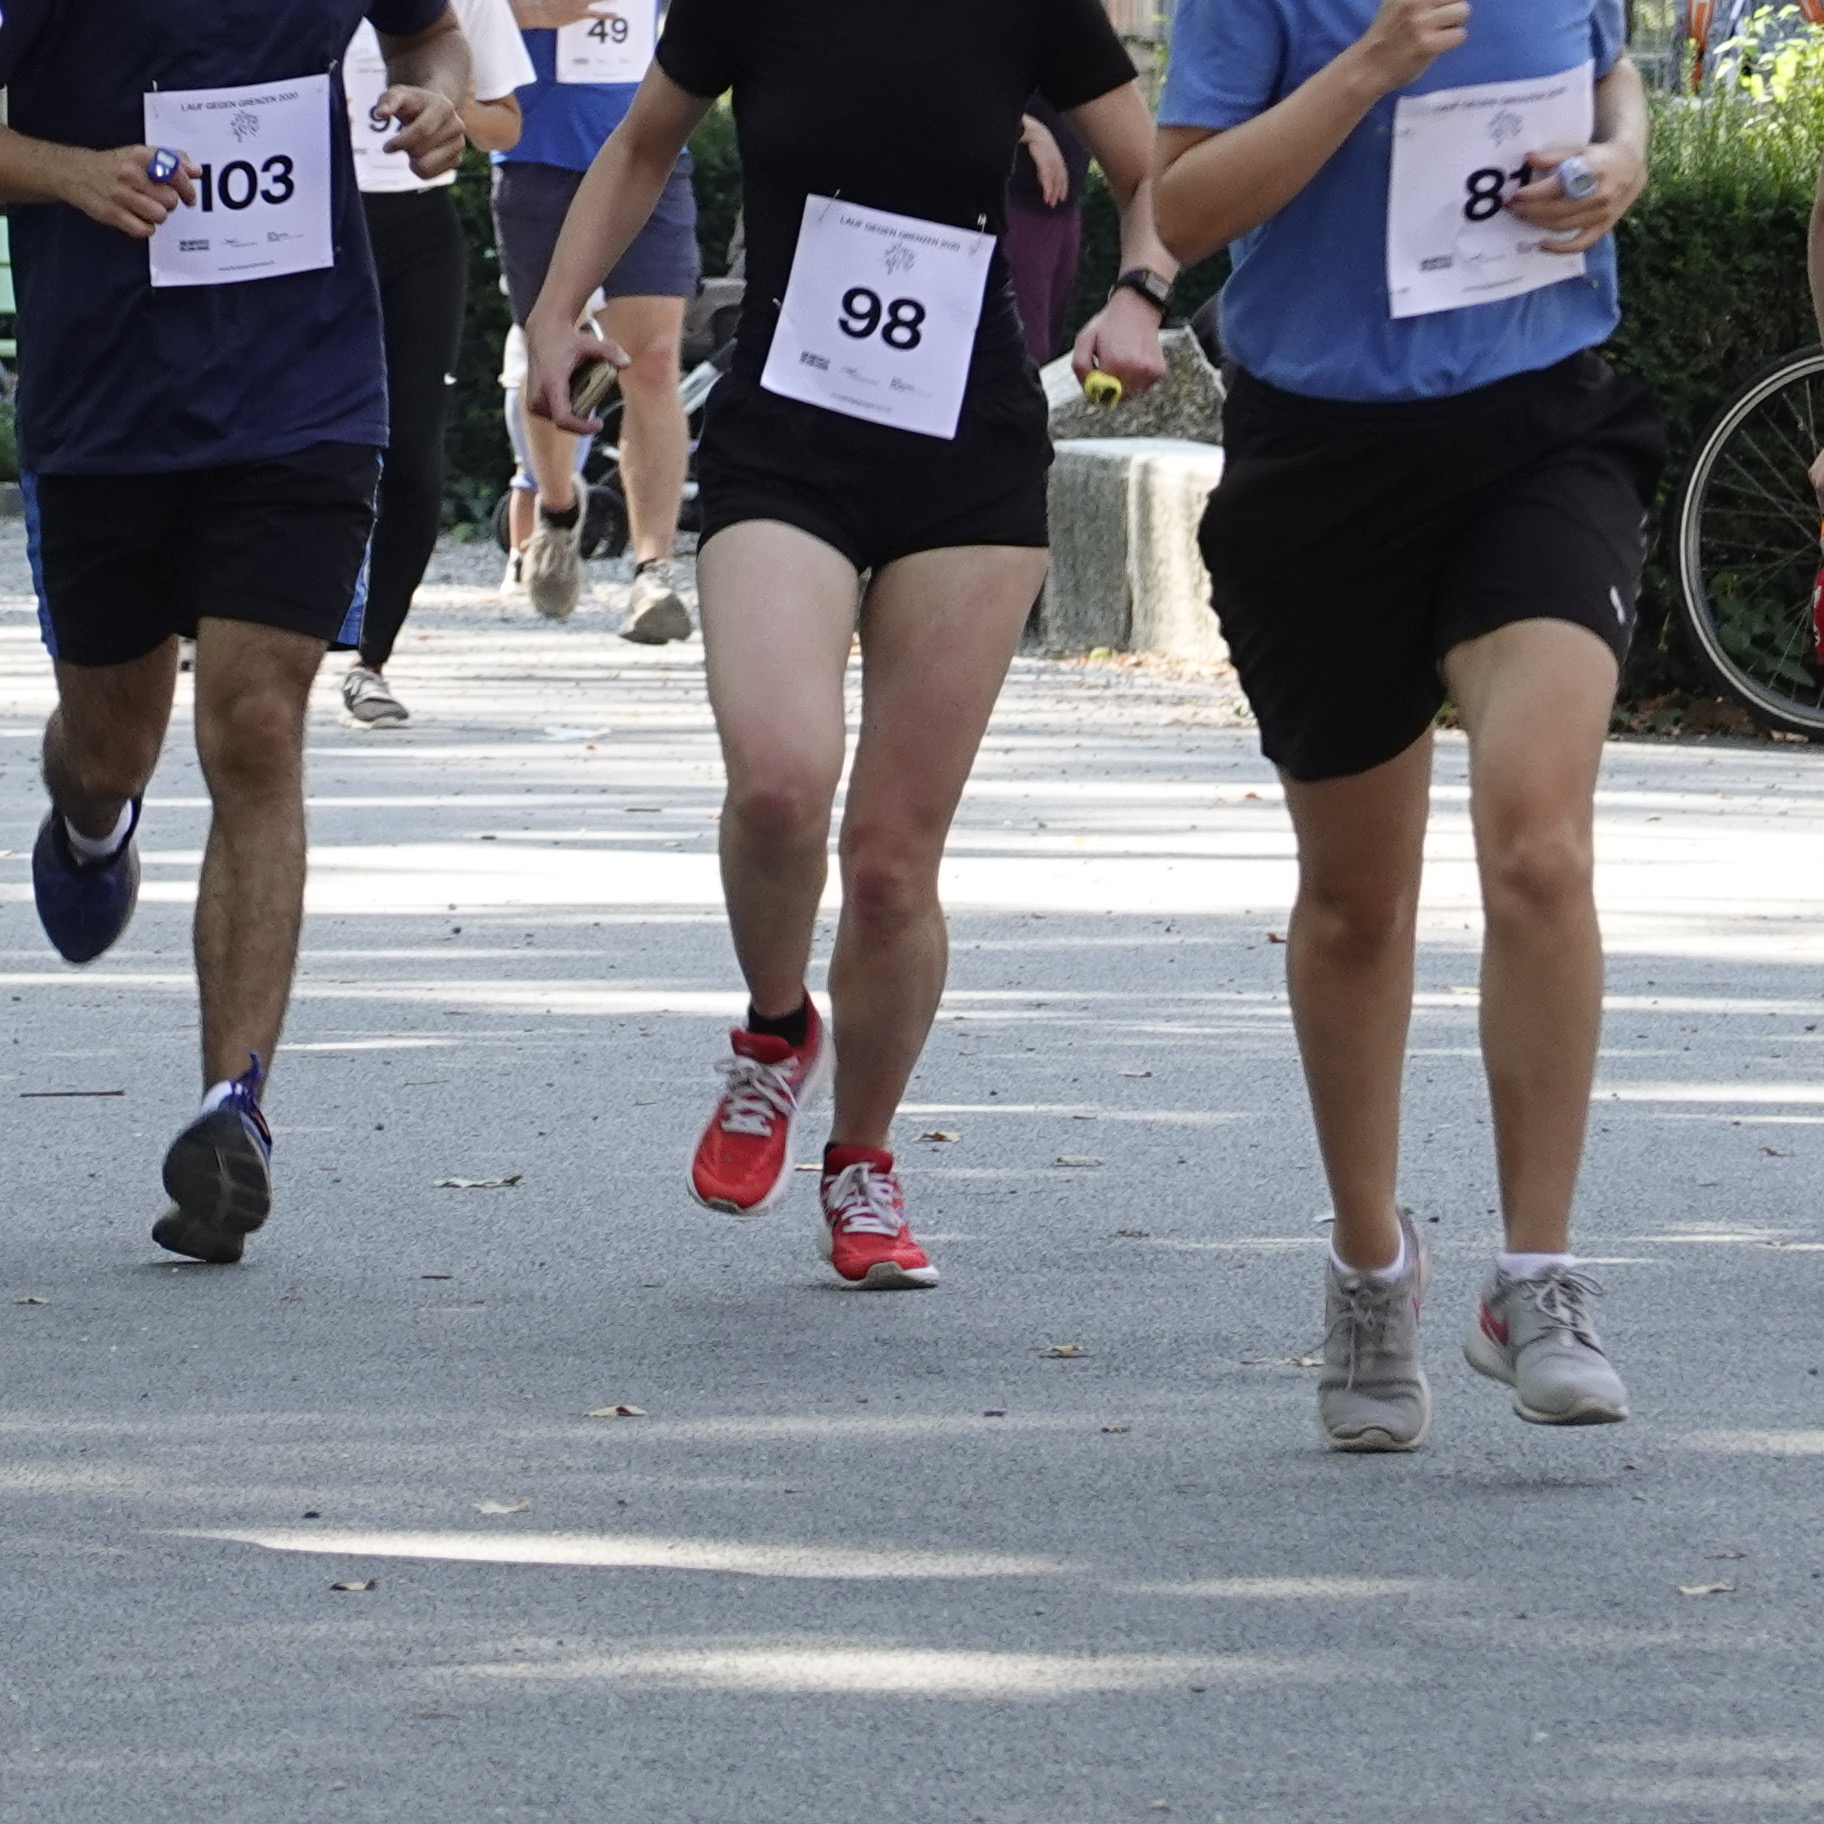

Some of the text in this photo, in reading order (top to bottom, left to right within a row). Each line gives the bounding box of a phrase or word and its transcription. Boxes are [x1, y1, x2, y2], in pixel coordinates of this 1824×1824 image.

[587, 17, 629, 45] 49
[200, 154, 295, 213] 103
[838, 286, 927, 351] 98
